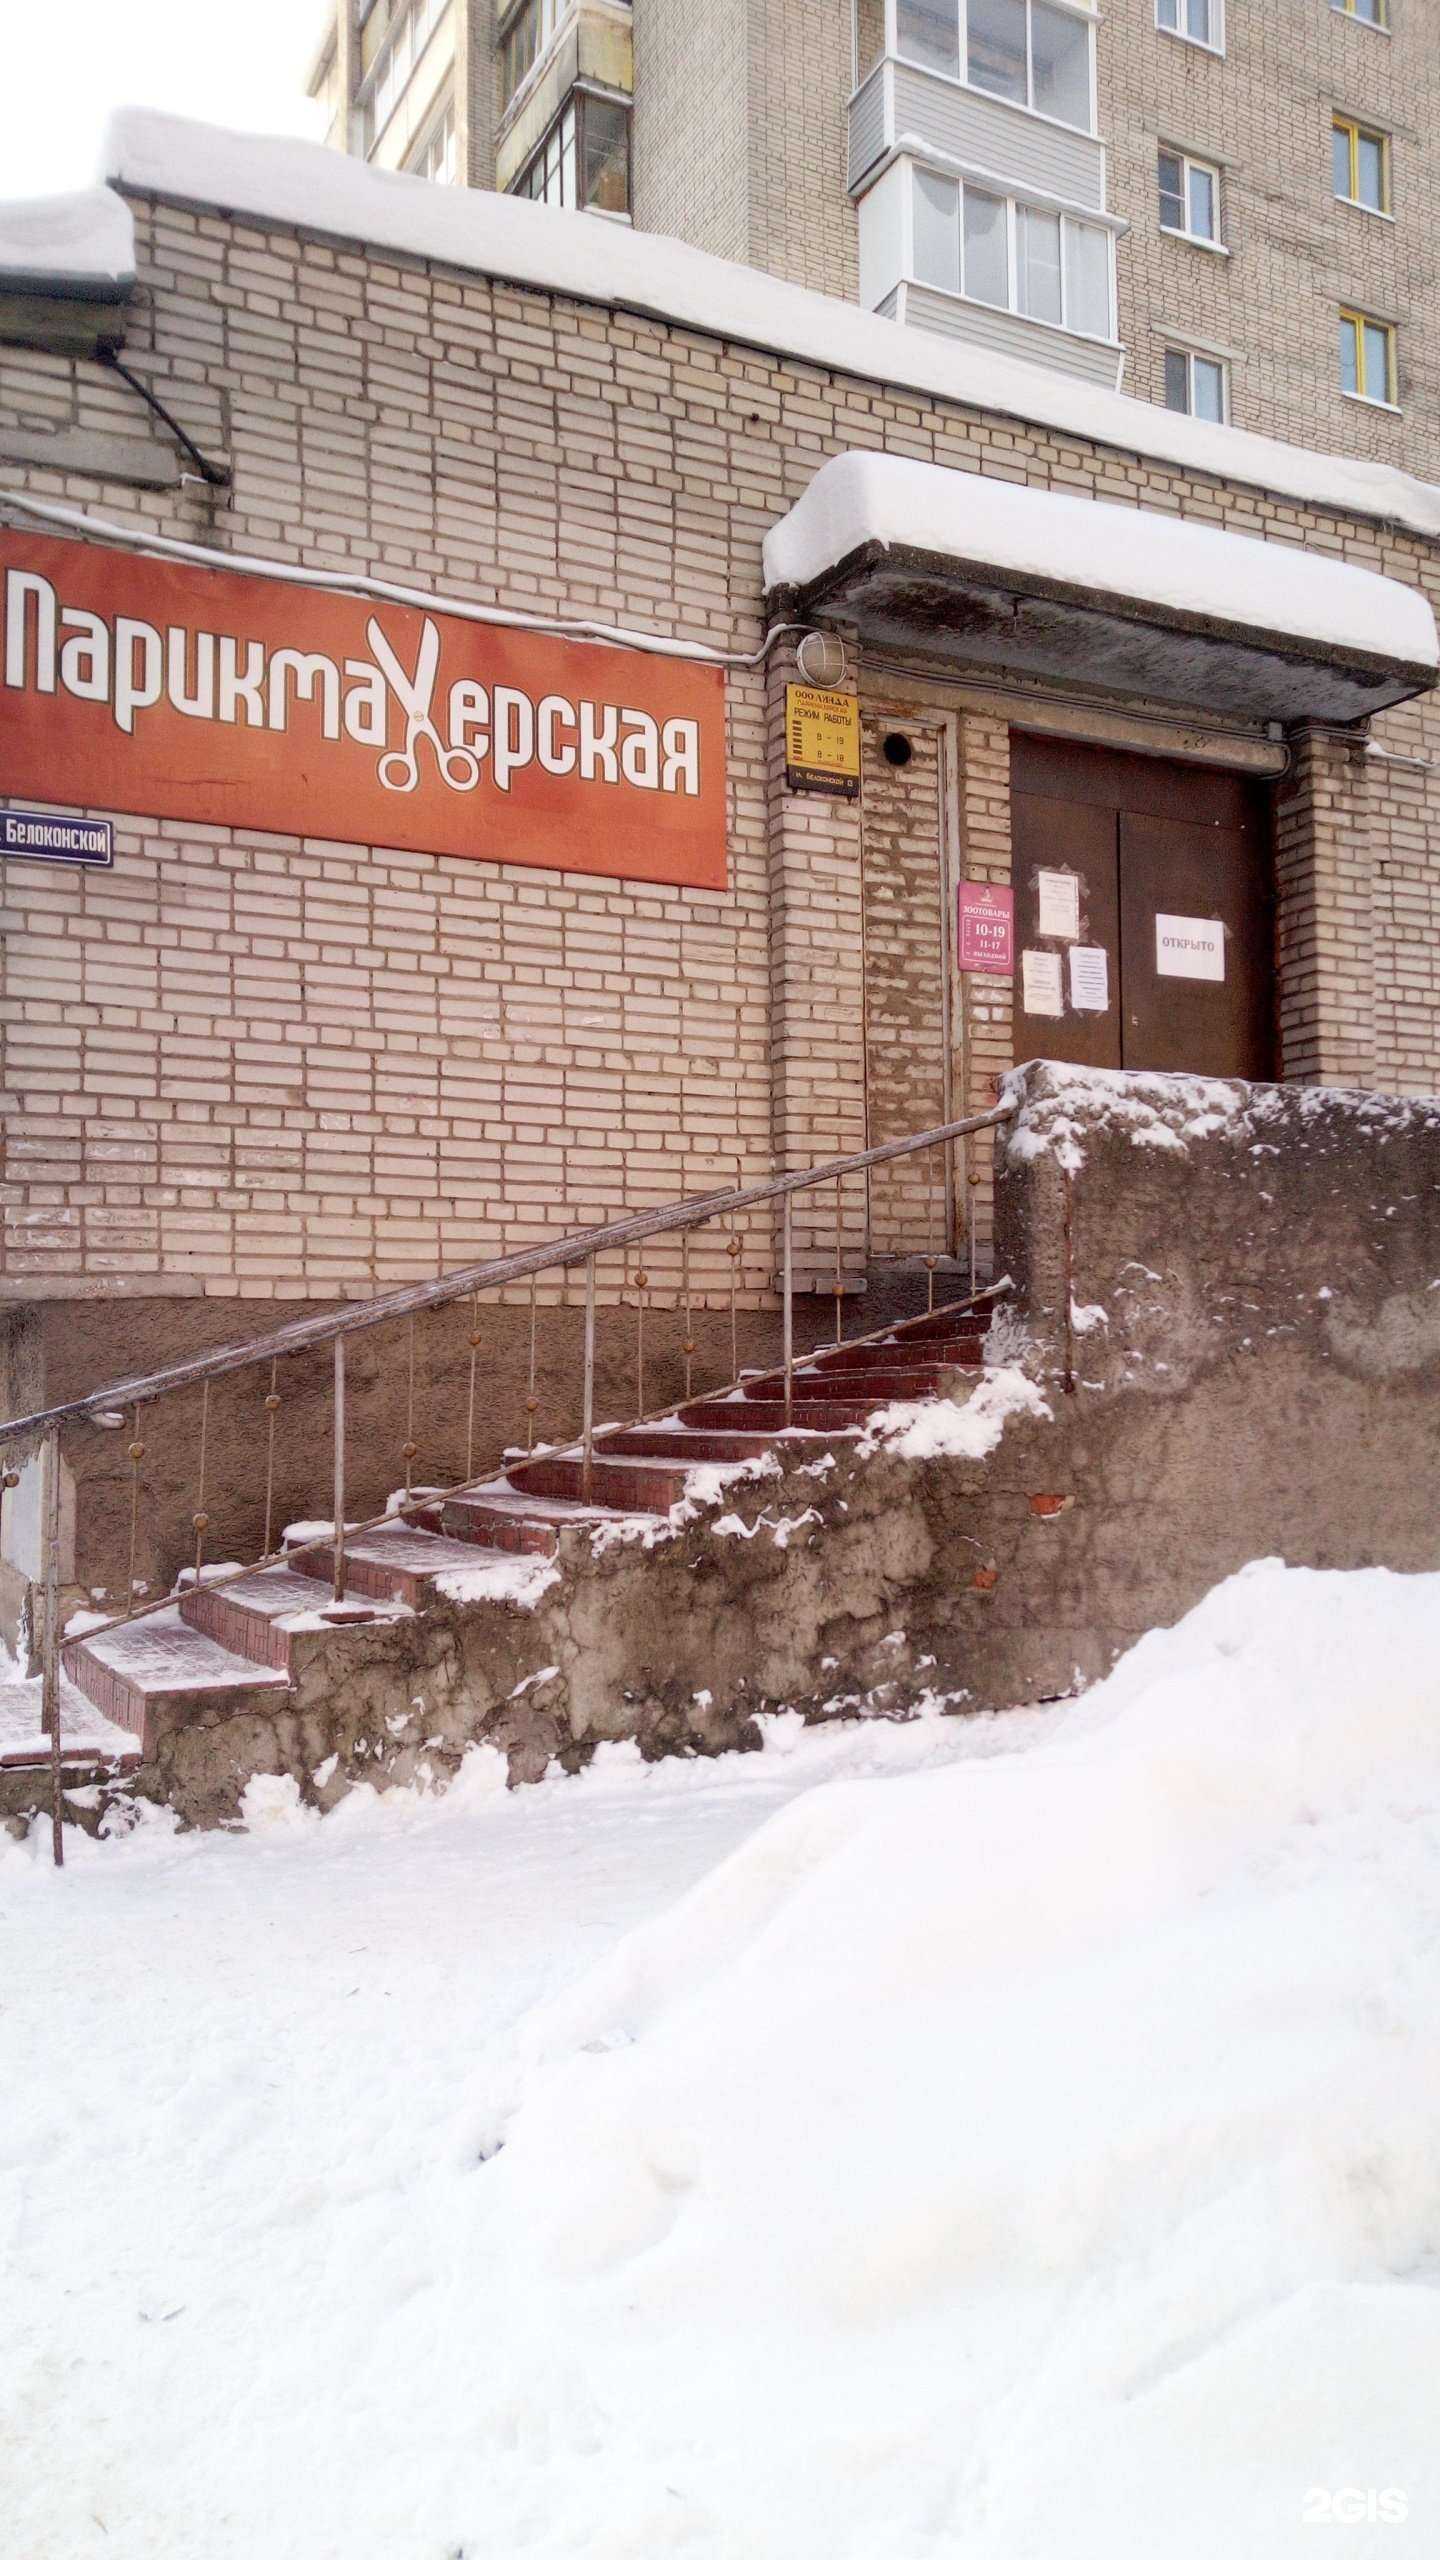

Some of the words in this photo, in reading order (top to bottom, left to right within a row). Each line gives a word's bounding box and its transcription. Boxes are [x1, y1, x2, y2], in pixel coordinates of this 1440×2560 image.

[795, 689, 814, 700] ООО
[793, 707, 820, 721] РЕЖИМ
[823, 713, 852, 726] РАБОТЫ
[6, 818, 107, 853] Белоконской
[963, 905, 1010, 919] ЗООТОВАРЫ
[975, 923, 1006, 938] 10-19
[979, 940, 1001, 950] 11-17
[1162, 936, 1215, 952] ОТКРЫТО
